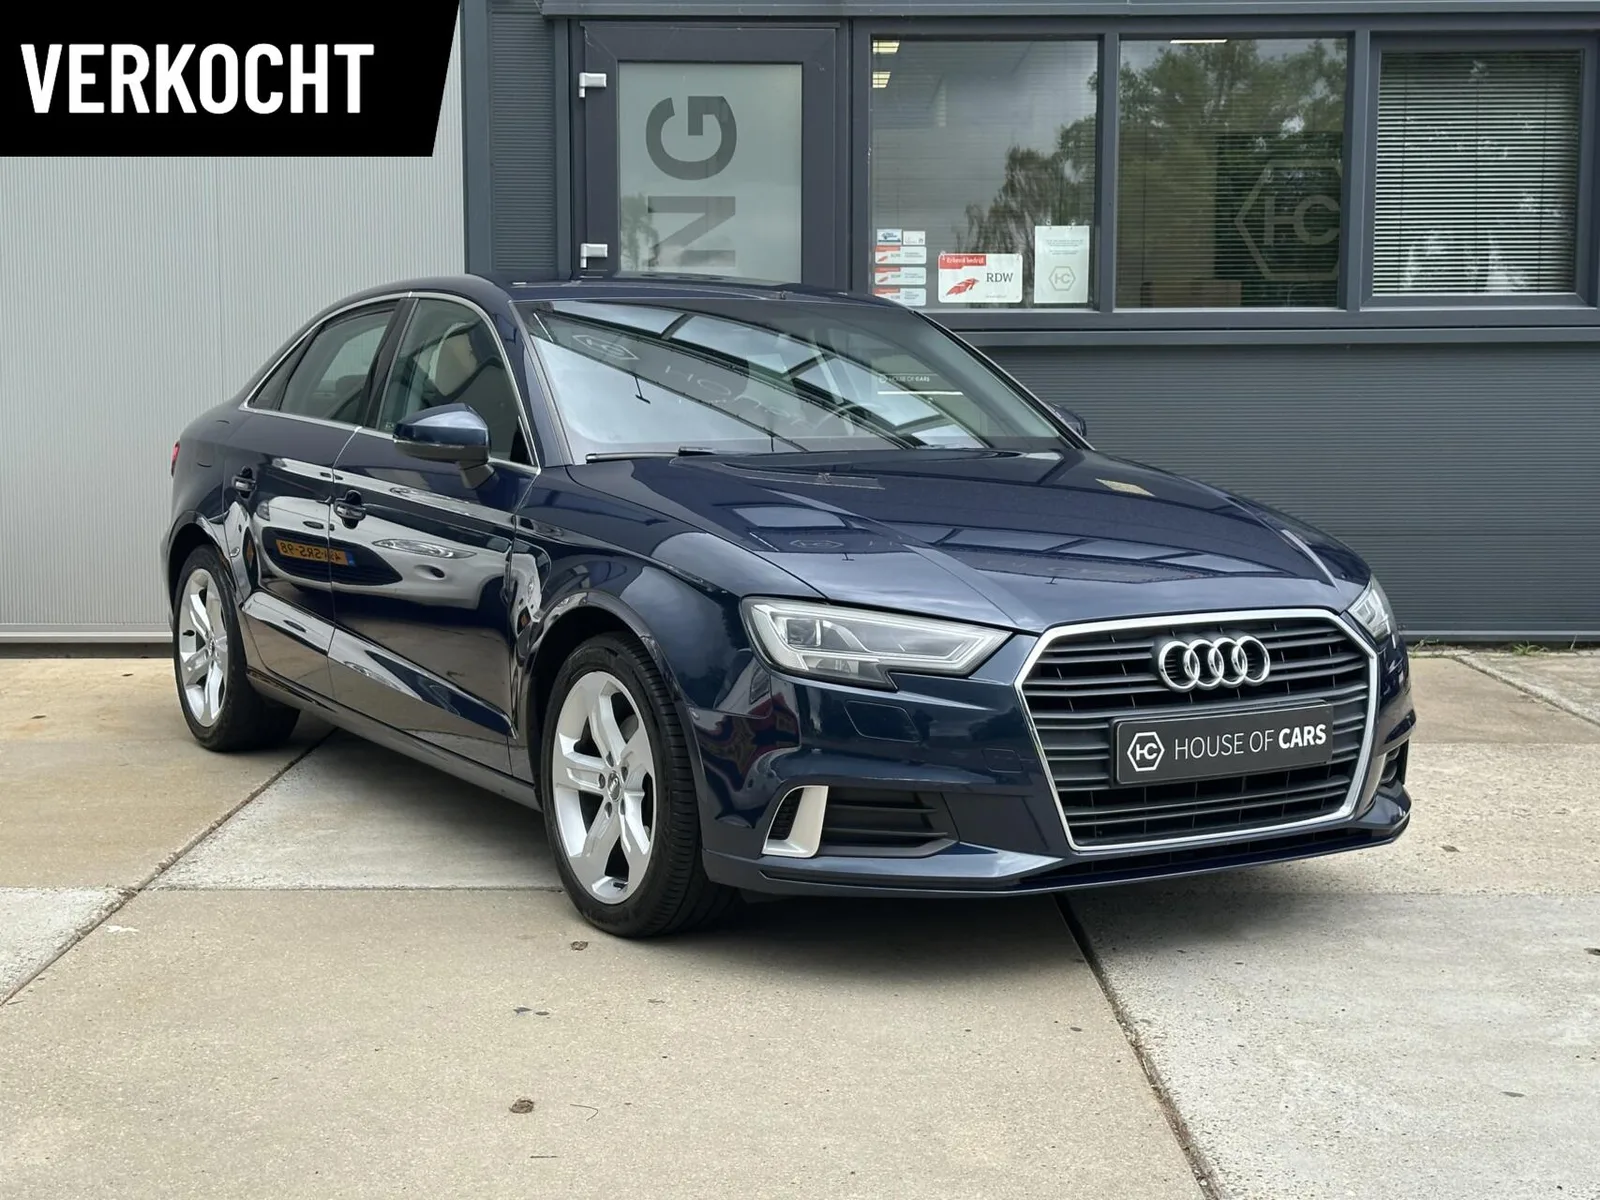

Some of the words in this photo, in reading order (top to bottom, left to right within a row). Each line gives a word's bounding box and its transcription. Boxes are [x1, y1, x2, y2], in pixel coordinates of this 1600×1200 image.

[986, 272, 1013, 283] RDW
[1174, 732, 1245, 760] HOUSE
[1249, 729, 1275, 753] OF
[1278, 724, 1327, 749] CARS
